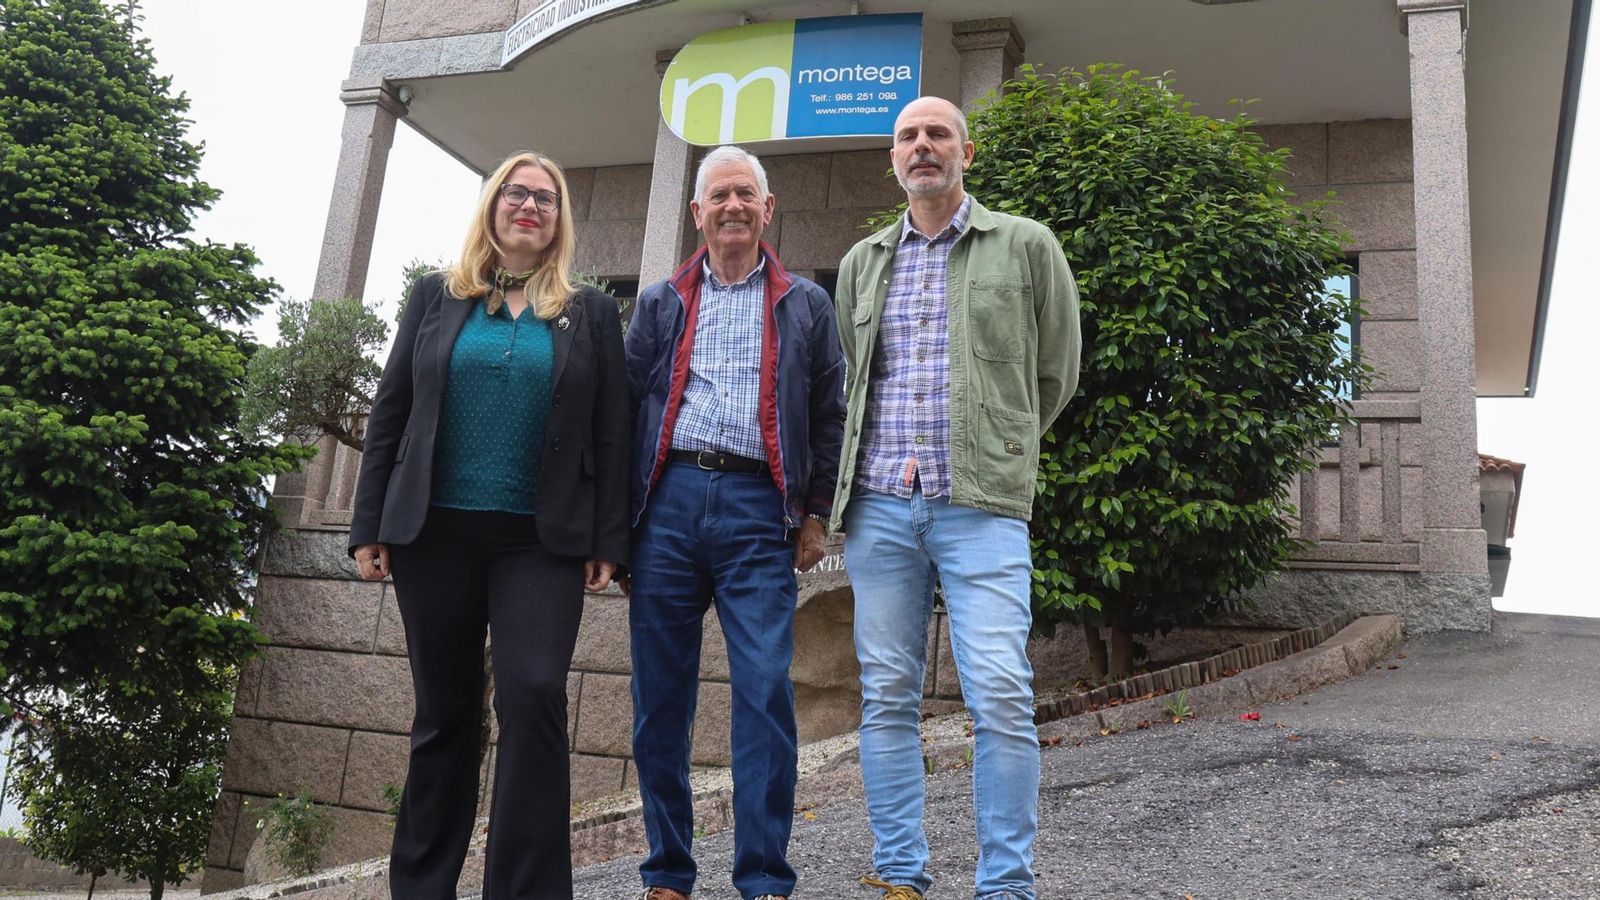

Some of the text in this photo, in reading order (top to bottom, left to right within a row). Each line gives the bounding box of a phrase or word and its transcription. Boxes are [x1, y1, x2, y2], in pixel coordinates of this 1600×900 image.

[507, 6, 556, 56] ELECTRICIDAD
[798, 64, 912, 84] montega
[810, 91, 898, 103] Telf.: 986 251 098
[815, 105, 889, 115] www.montega.es
